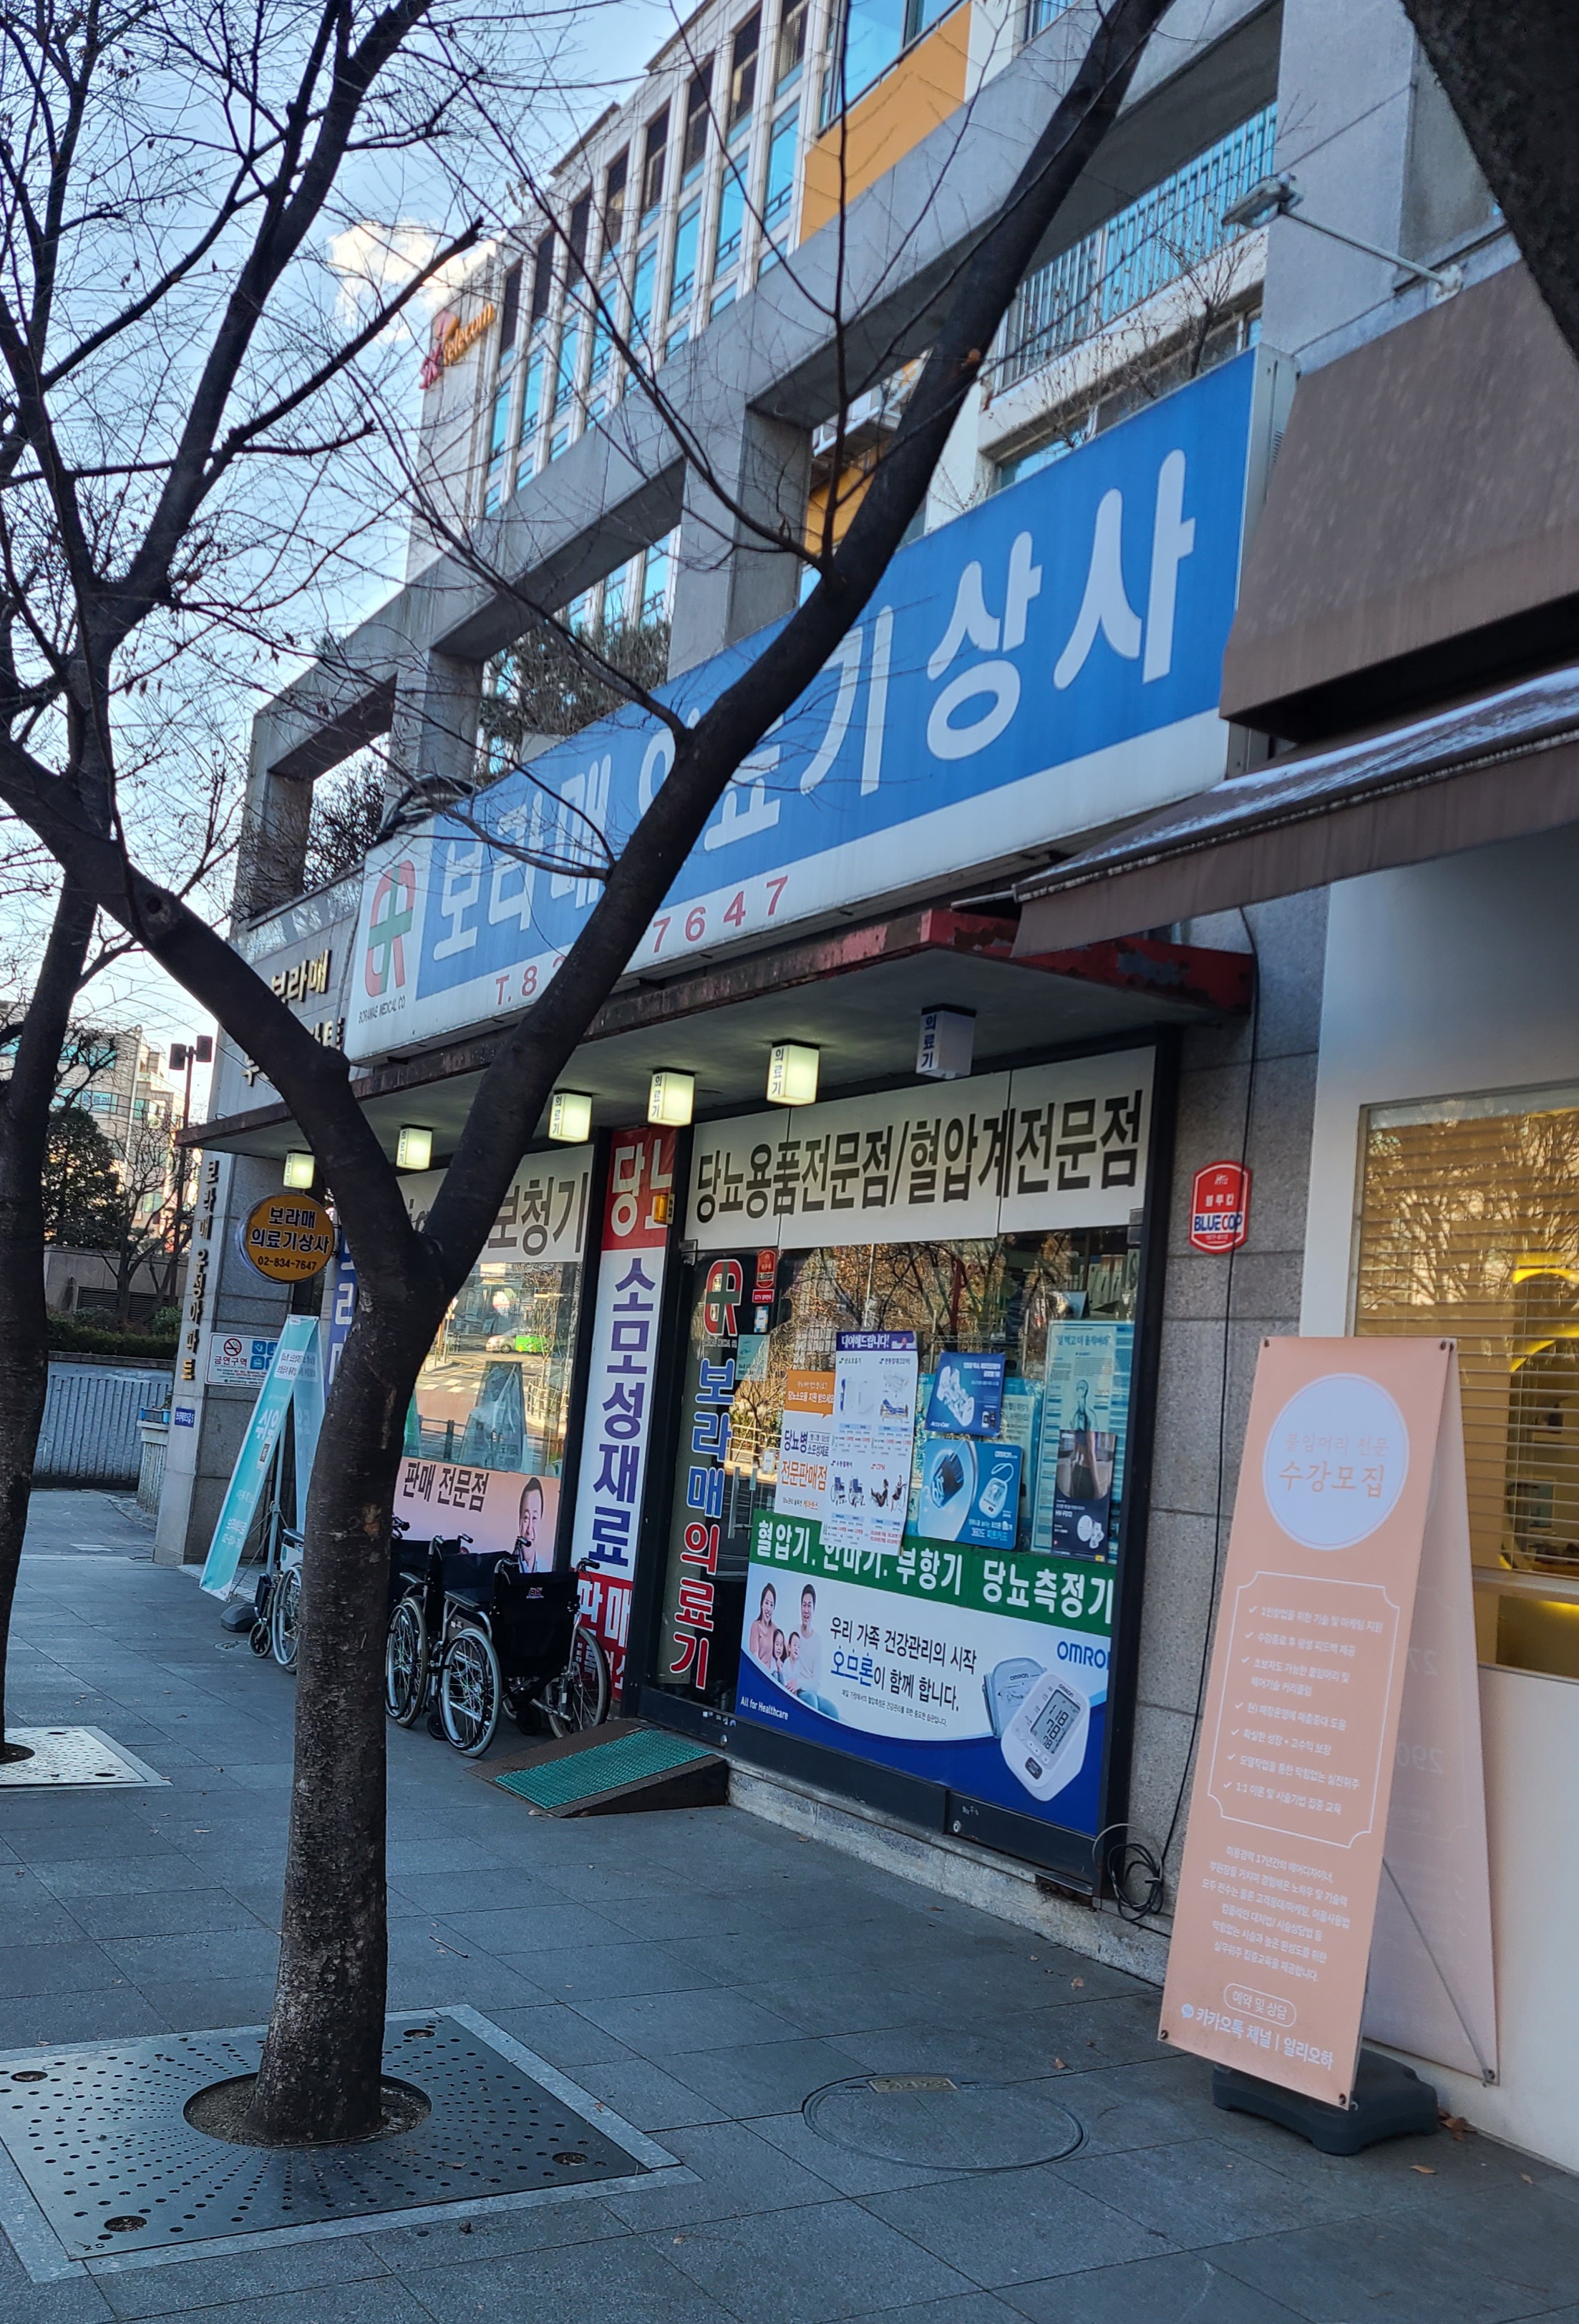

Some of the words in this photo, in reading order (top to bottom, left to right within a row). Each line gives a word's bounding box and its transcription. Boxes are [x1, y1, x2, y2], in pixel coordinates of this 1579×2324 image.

[442, 302, 495, 366] telecom
[433, 754, 611, 962] 보라매
[927, 449, 1195, 760] 상사
[271, 948, 331, 1003] 보라매
[922, 1013, 937, 1069] 의료기
[771, 1047, 784, 1095] 의료기
[553, 1095, 563, 1135] 의료기
[651, 1074, 663, 1118] 의료기
[268, 1206, 316, 1230] 보라매
[487, 1172, 588, 1256] 보청기
[1194, 1212, 1243, 1232] BLUECOP
[250, 1229, 330, 1254] 의료기상사
[258, 1254, 318, 1271] 02-834-7647
[214, 1356, 248, 1367] 금연구역
[588, 1258, 656, 1567] 소모성재료
[686, 1357, 735, 1518] 보라매
[784, 1429, 808, 1454] 당뇨병
[1358, 1436, 1389, 1457] 전문
[403, 1462, 436, 1502] 판매
[437, 1467, 490, 1512] 전문점
[781, 1460, 827, 1491] 전문판매점
[1279, 1459, 1384, 1498] 수강모집
[669, 1522, 721, 1690] 의료기
[895, 1549, 963, 1595] 부항기
[983, 1560, 1114, 1624] 당뇨측정기
[830, 1617, 852, 1643] 우리
[857, 1624, 880, 1650] 가족
[885, 1630, 946, 1667] 건강관리의
[951, 1646, 976, 1675] 시작
[1057, 1641, 1110, 1670] OMRO
[831, 1645, 885, 1691] 오므론이
[890, 1668, 914, 1699] 함께
[919, 1677, 959, 1711] 합니다.
[1058, 1683, 1074, 1698] OMRON
[740, 1696, 749, 1708] All
[758, 1701, 788, 1720] Healthcare
[1233, 1990, 1253, 2008] 예약
[1255, 1998, 1265, 2013] 및
[1267, 2002, 1288, 2021] 상담
[1196, 2008, 1244, 2038] 카카오톡
[1247, 2025, 1271, 2048] 채널
[1283, 2037, 1333, 2071] 일리오하
